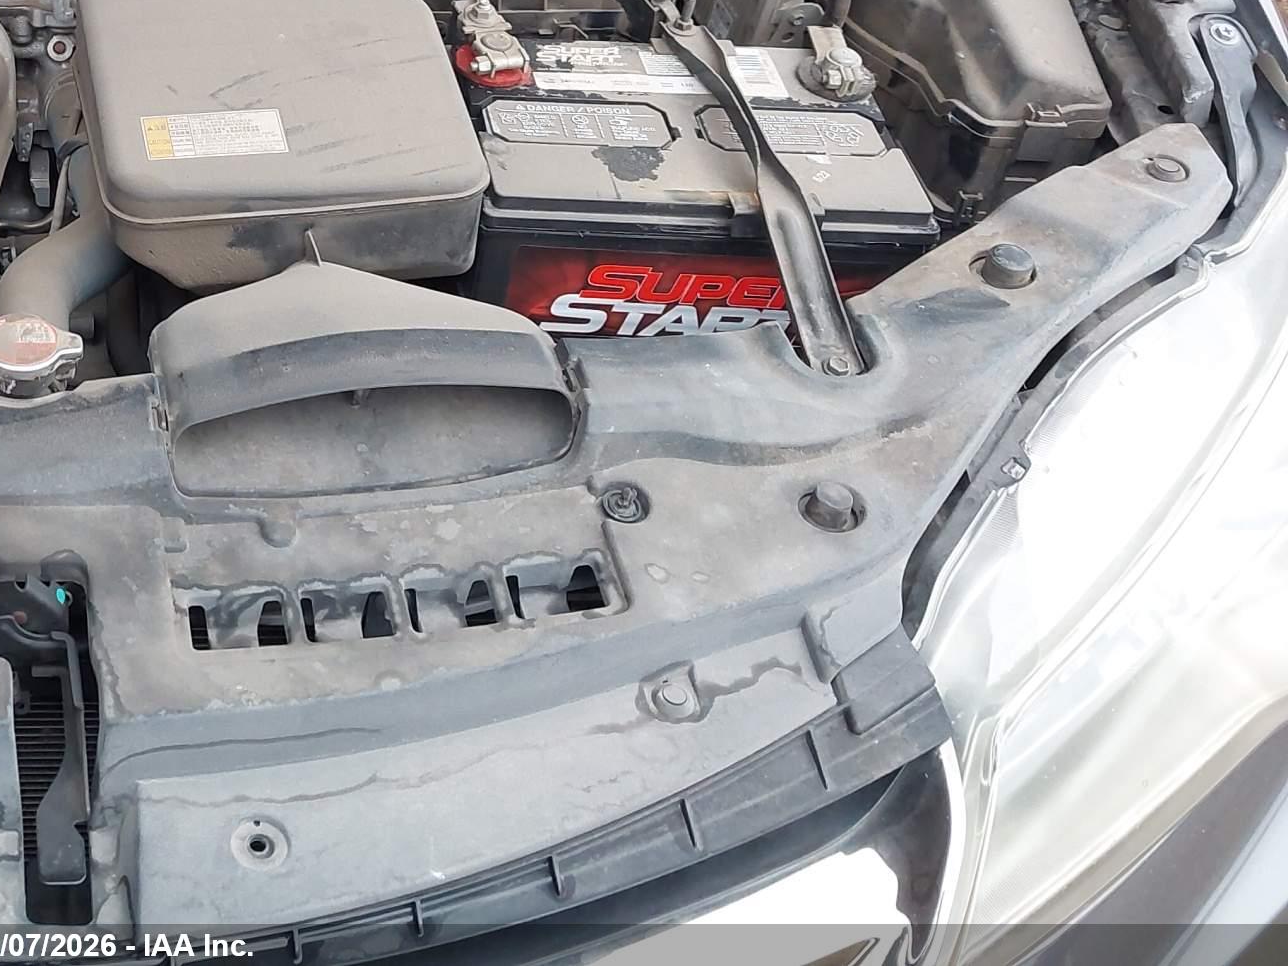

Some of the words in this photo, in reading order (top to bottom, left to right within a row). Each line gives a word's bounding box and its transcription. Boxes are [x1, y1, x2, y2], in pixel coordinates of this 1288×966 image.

[543, 43, 620, 55] SUPER
[535, 50, 622, 63] START
[527, 105, 574, 113] DANGER
[586, 107, 632, 115] POISON
